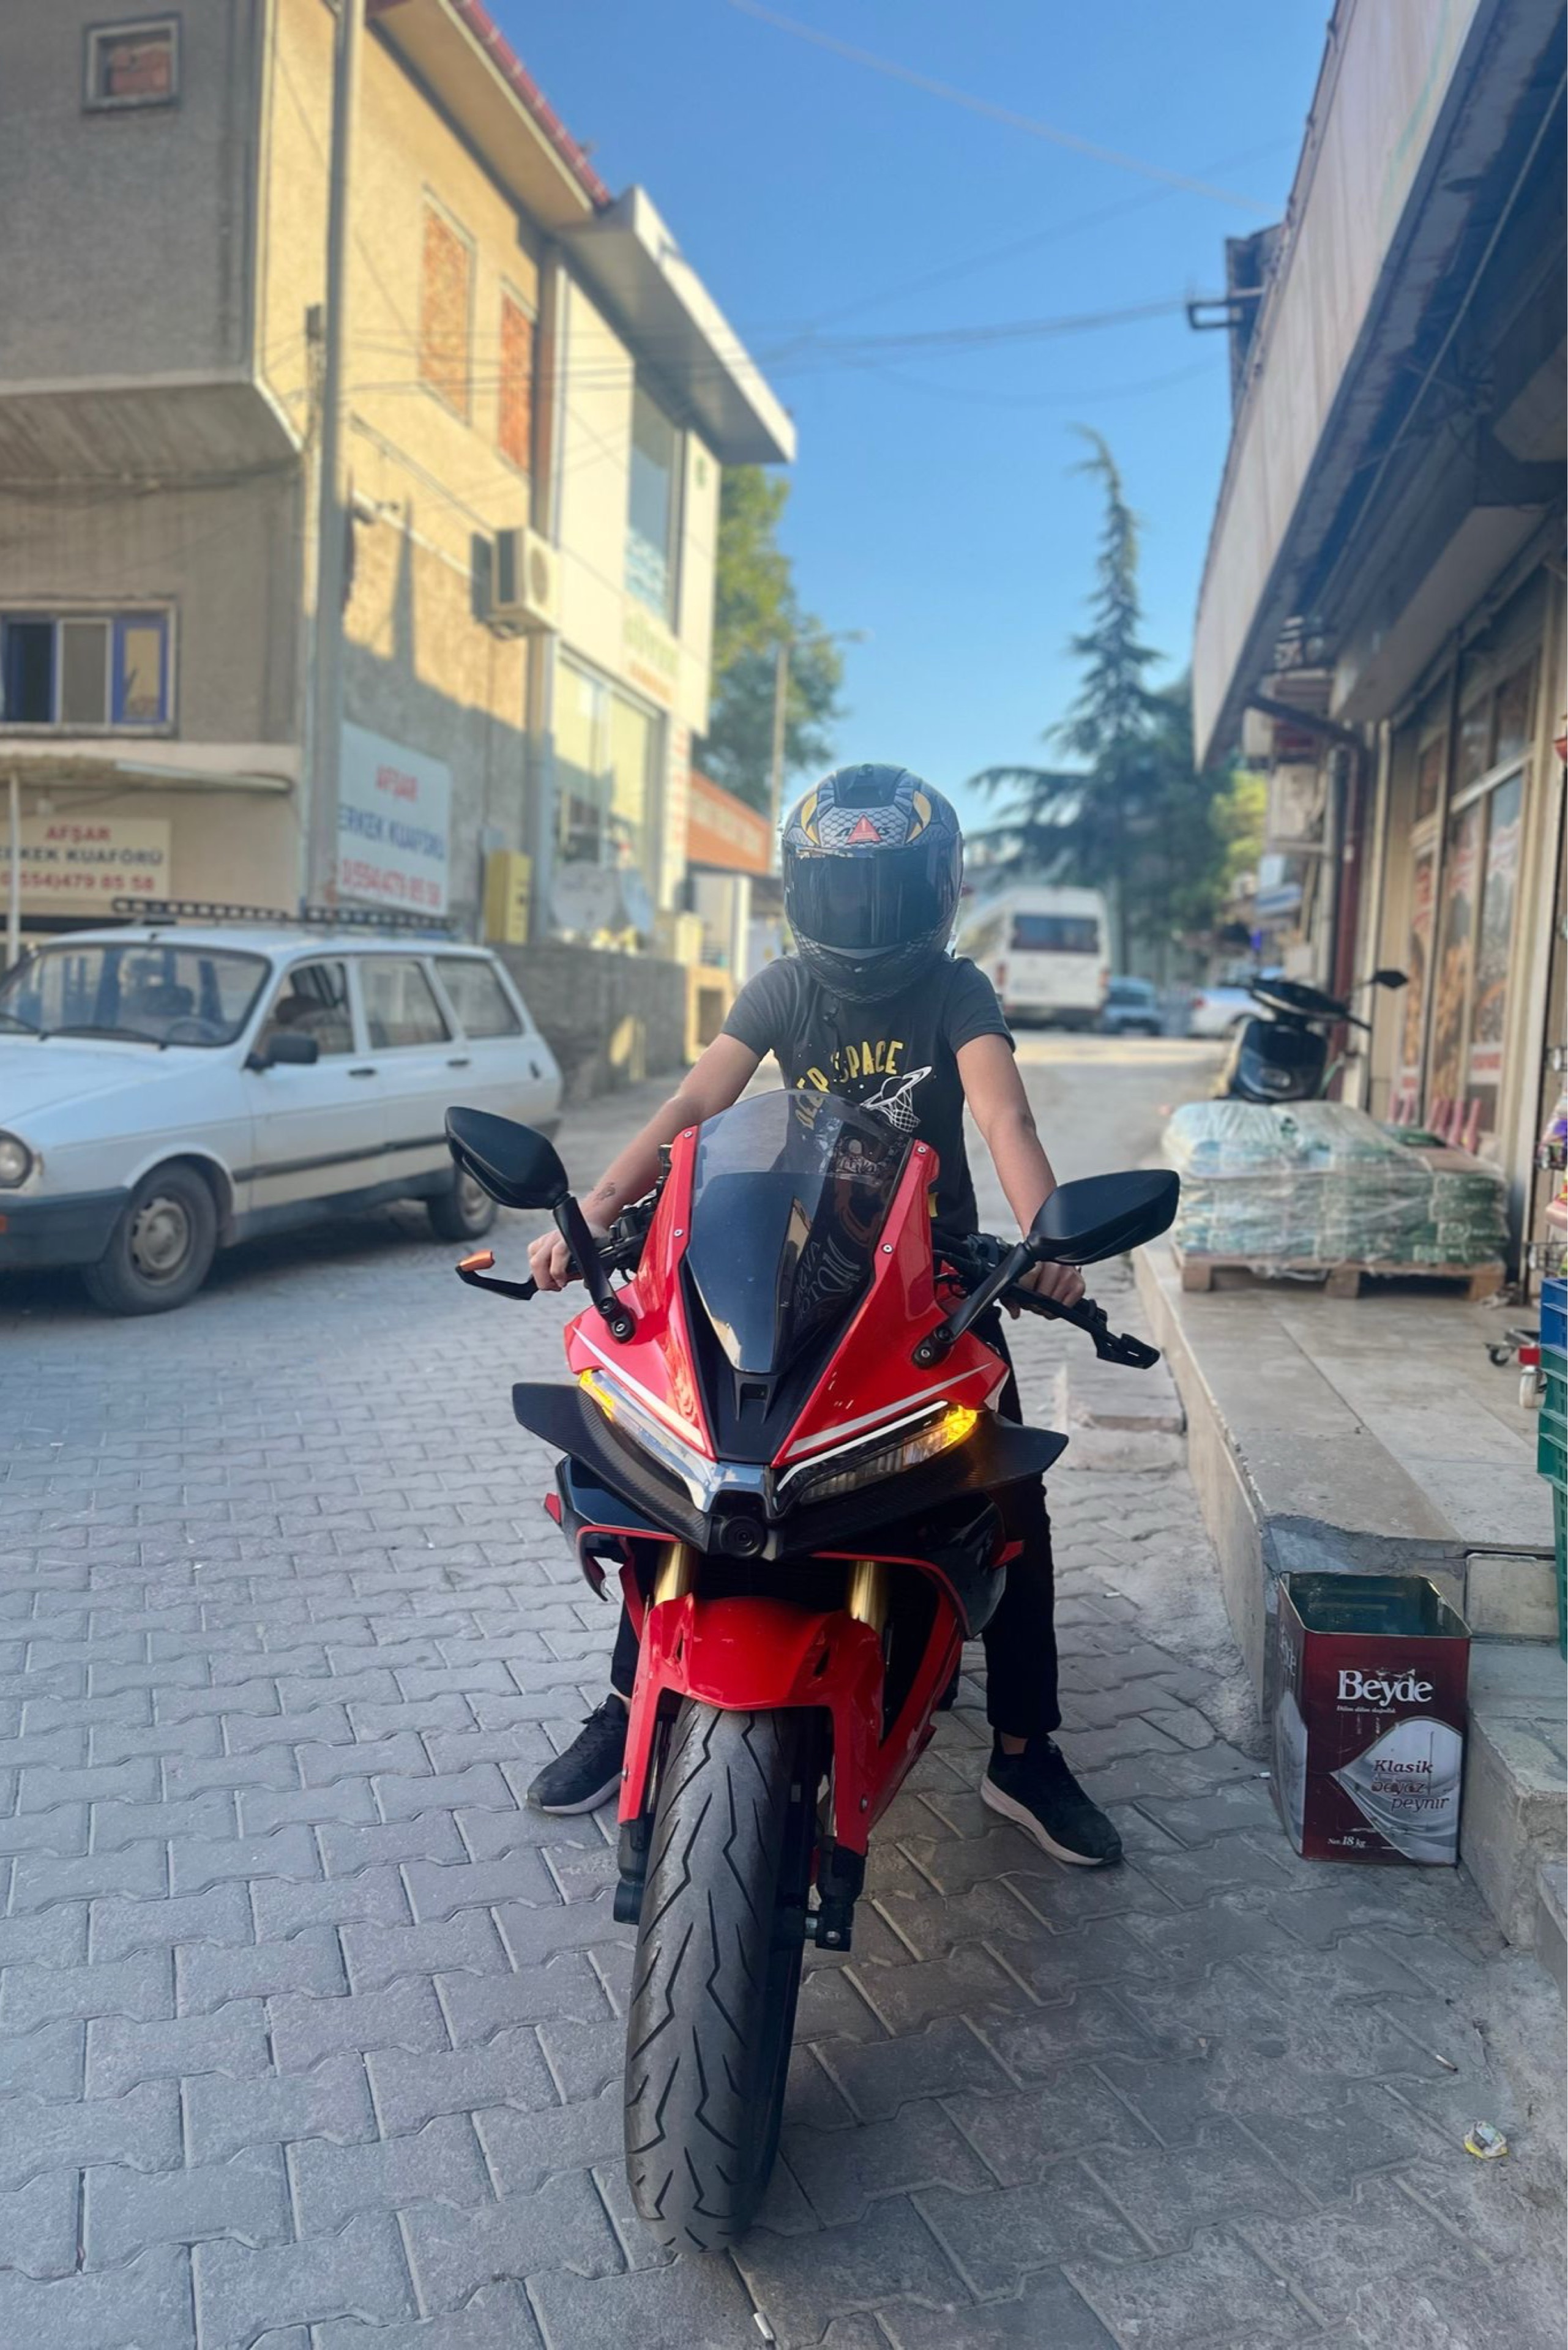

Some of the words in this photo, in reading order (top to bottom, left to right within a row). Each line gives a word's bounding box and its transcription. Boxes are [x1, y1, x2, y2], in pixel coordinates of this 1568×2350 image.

[47, 826, 112, 844] AFŞAR
[65, 848, 164, 866] KUAFÖRÜ
[1, 870, 95, 888] 0554)479
[831, 1040, 904, 1083] SPACE
[1337, 1669, 1434, 1707] Beyde
[1373, 1759, 1433, 1774] Klasik
[1342, 1836, 1354, 1845] 18
